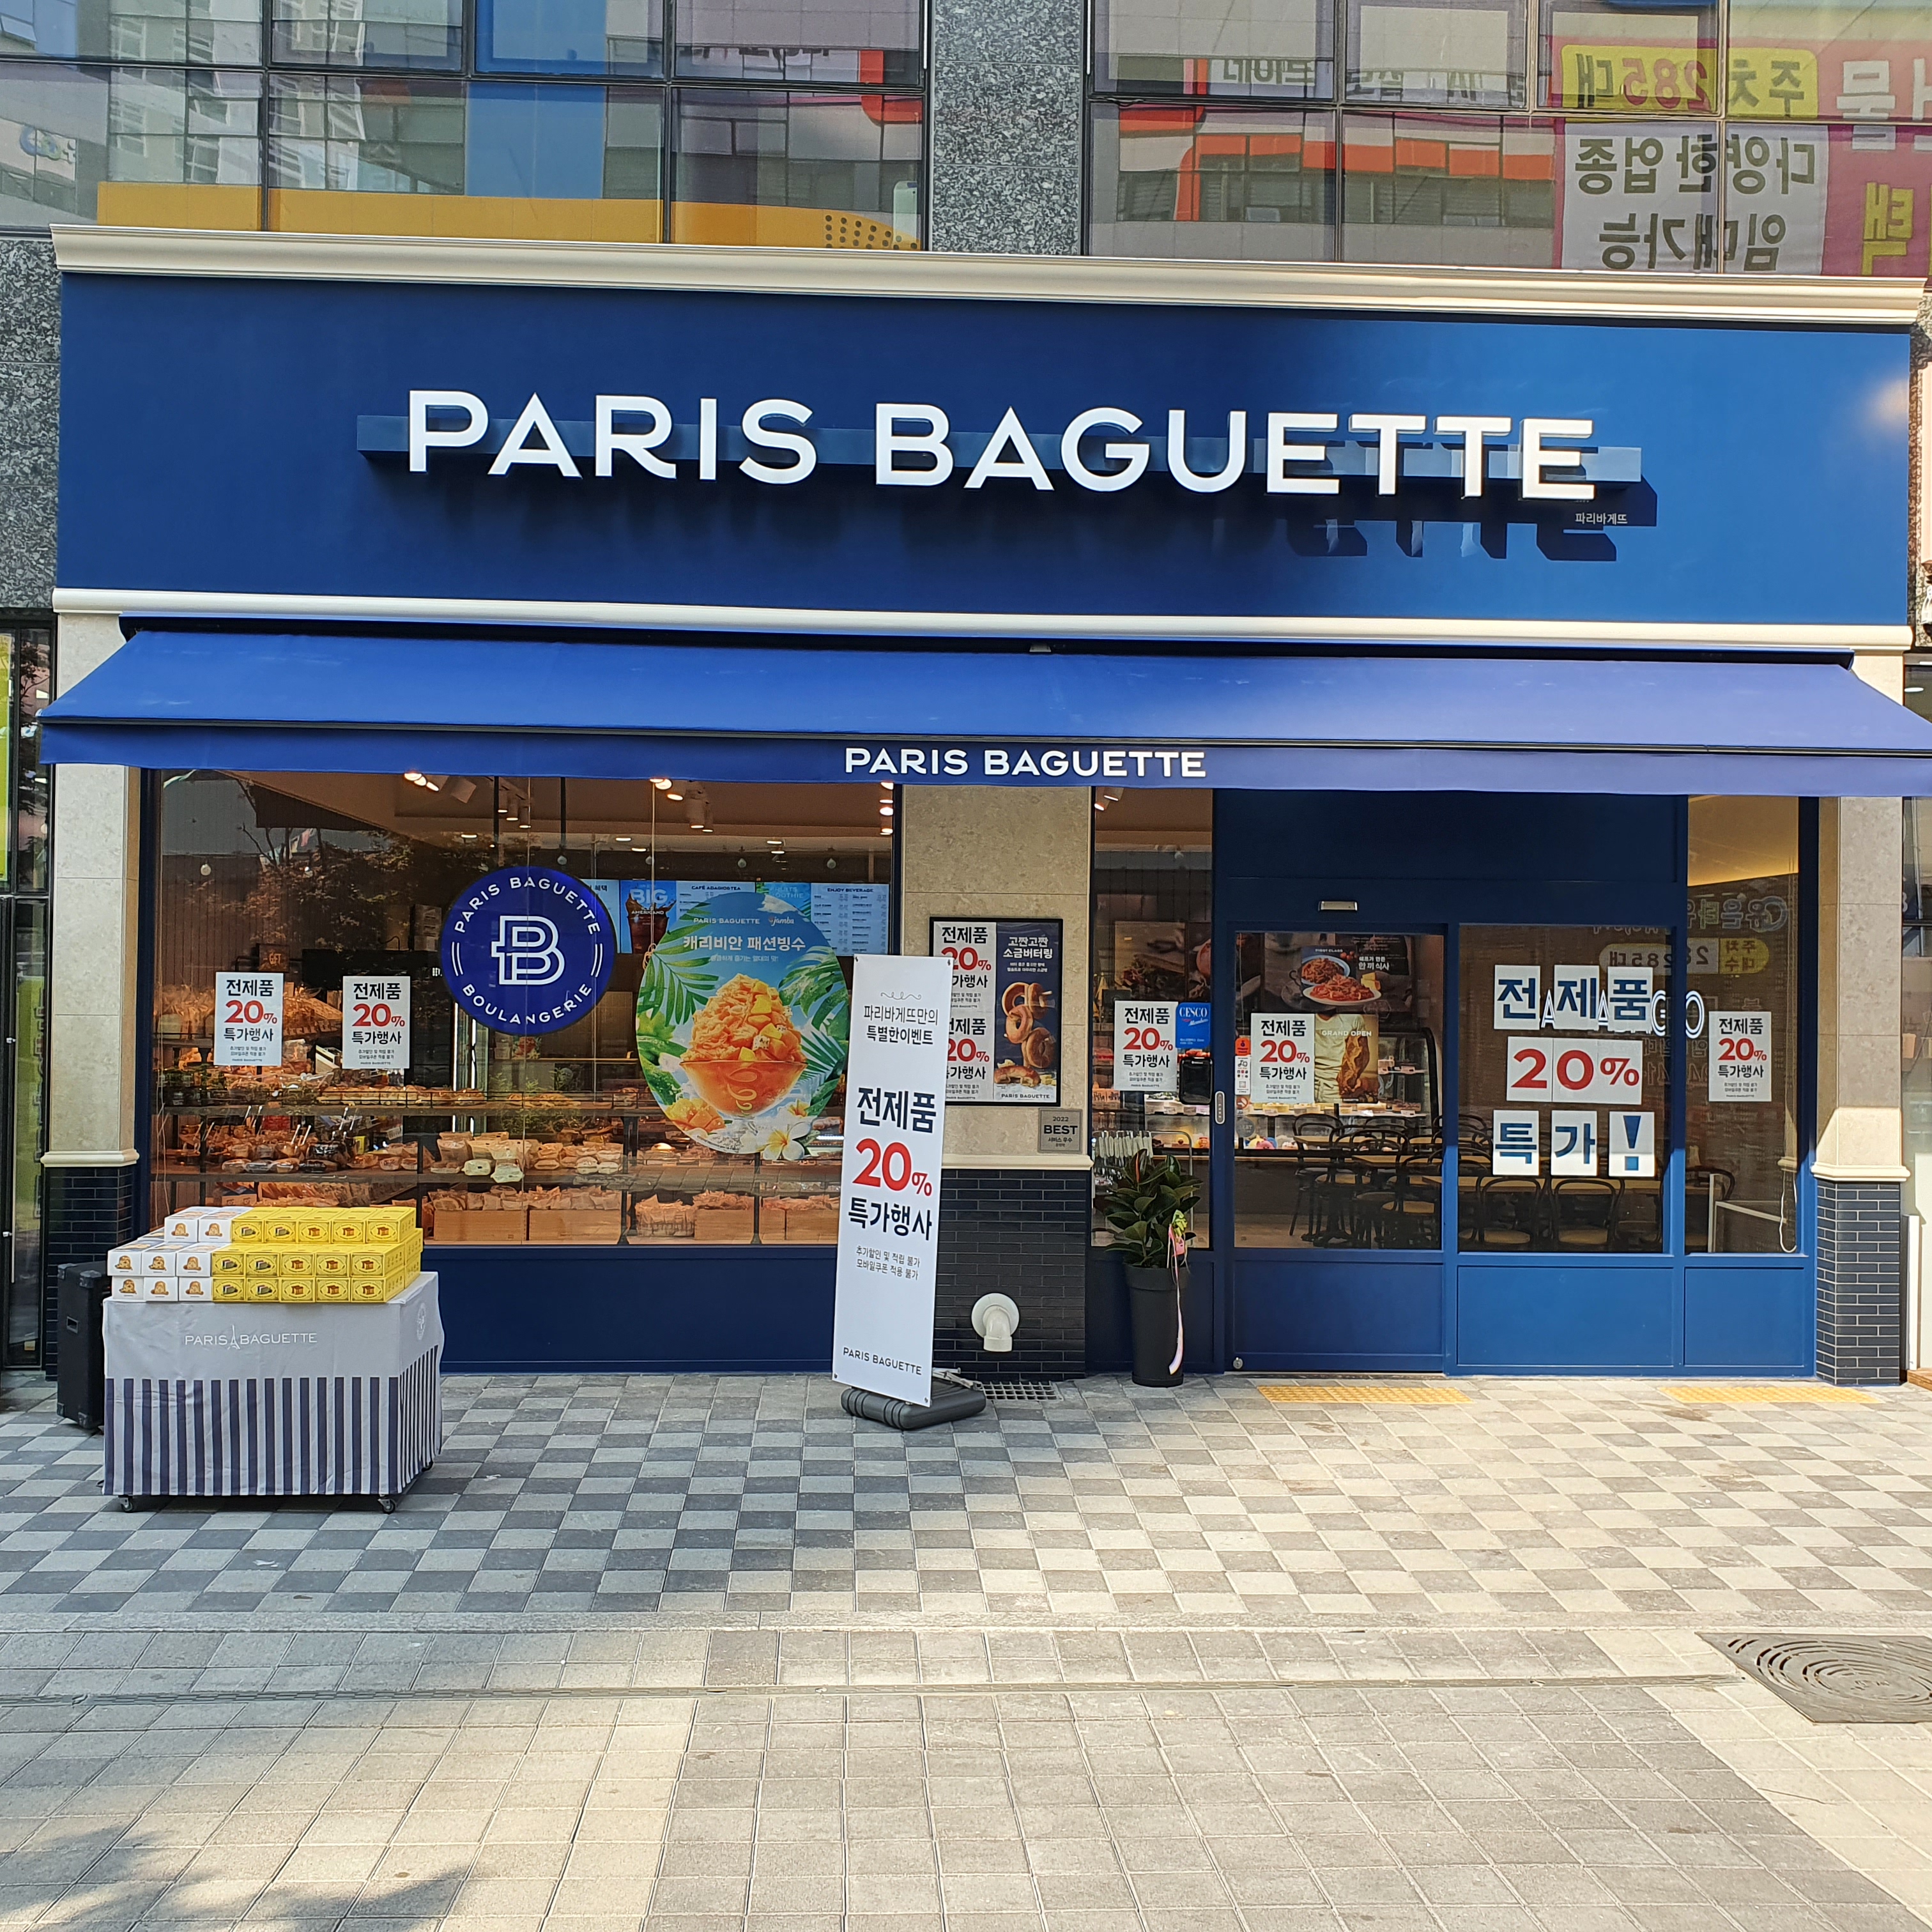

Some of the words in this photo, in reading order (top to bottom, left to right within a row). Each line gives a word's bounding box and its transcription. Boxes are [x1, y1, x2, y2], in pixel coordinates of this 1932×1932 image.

[409, 389, 818, 484] PARIS
[875, 402, 1596, 500] BAGUETTE
[1574, 512, 1628, 525] 파리바게뜨
[845, 747, 969, 776] PARIS
[984, 749, 1206, 778] BAGUETTE
[454, 884, 501, 933] PARIS
[509, 877, 601, 935] BAGUETTE
[629, 889, 668, 905] BIG
[770, 916, 795, 926] jamba
[683, 935, 743, 951] 캐리비안
[747, 936, 806, 952] 패션빙수
[941, 926, 989, 945] 전제품
[1008, 937, 1048, 947] 고짠고짠
[1003, 948, 1053, 959] 소금버터링
[226, 979, 275, 997] 전제품
[951, 974, 988, 989] 가행사
[353, 983, 402, 1000] 전제품
[1496, 977, 1652, 1021] 전제품
[224, 1000, 278, 1025] 20%
[462, 983, 592, 1025] BOULANGERIE
[1179, 1007, 1208, 1017] CESCO
[351, 1002, 406, 1027] 20%
[863, 1005, 939, 1026] 파리바게뜨만의
[1124, 1007, 1170, 1025] 전제품
[224, 1027, 274, 1042] 특가행사
[866, 1025, 934, 1046] 특별한이벤트
[1261, 1020, 1307, 1036] 전제품
[1719, 1018, 1763, 1034] 전제품
[351, 1031, 402, 1045] 특가행사
[1123, 1027, 1174, 1051] 20%
[1259, 1039, 1310, 1063] 20%
[1717, 1038, 1767, 1061] 20%
[1123, 1054, 1170, 1068] 특가행사
[1510, 1048, 1639, 1091] 20%
[1259, 1066, 1307, 1080] 특가행사
[1717, 1064, 1764, 1078] 특가행사
[857, 1087, 937, 1134] 전제품
[1043, 1124, 1078, 1135] BEST
[1495, 1115, 1642, 1171] 특가!
[852, 1138, 933, 1197] 20%
[848, 1196, 933, 1241] 특가행사
[856, 1245, 882, 1261] 추가할인
[892, 1253, 905, 1265] 적립
[907, 1256, 921, 1269] 불가
[856, 1258, 889, 1275] 모바일쿠폰
[890, 1264, 903, 1278] 적용
[905, 1267, 919, 1281] 불가
[185, 1335, 227, 1346] PARIS
[240, 1333, 318, 1345] BAGUETTE
[843, 1346, 870, 1362] PARIS
[872, 1354, 923, 1376] BAGUETTE
